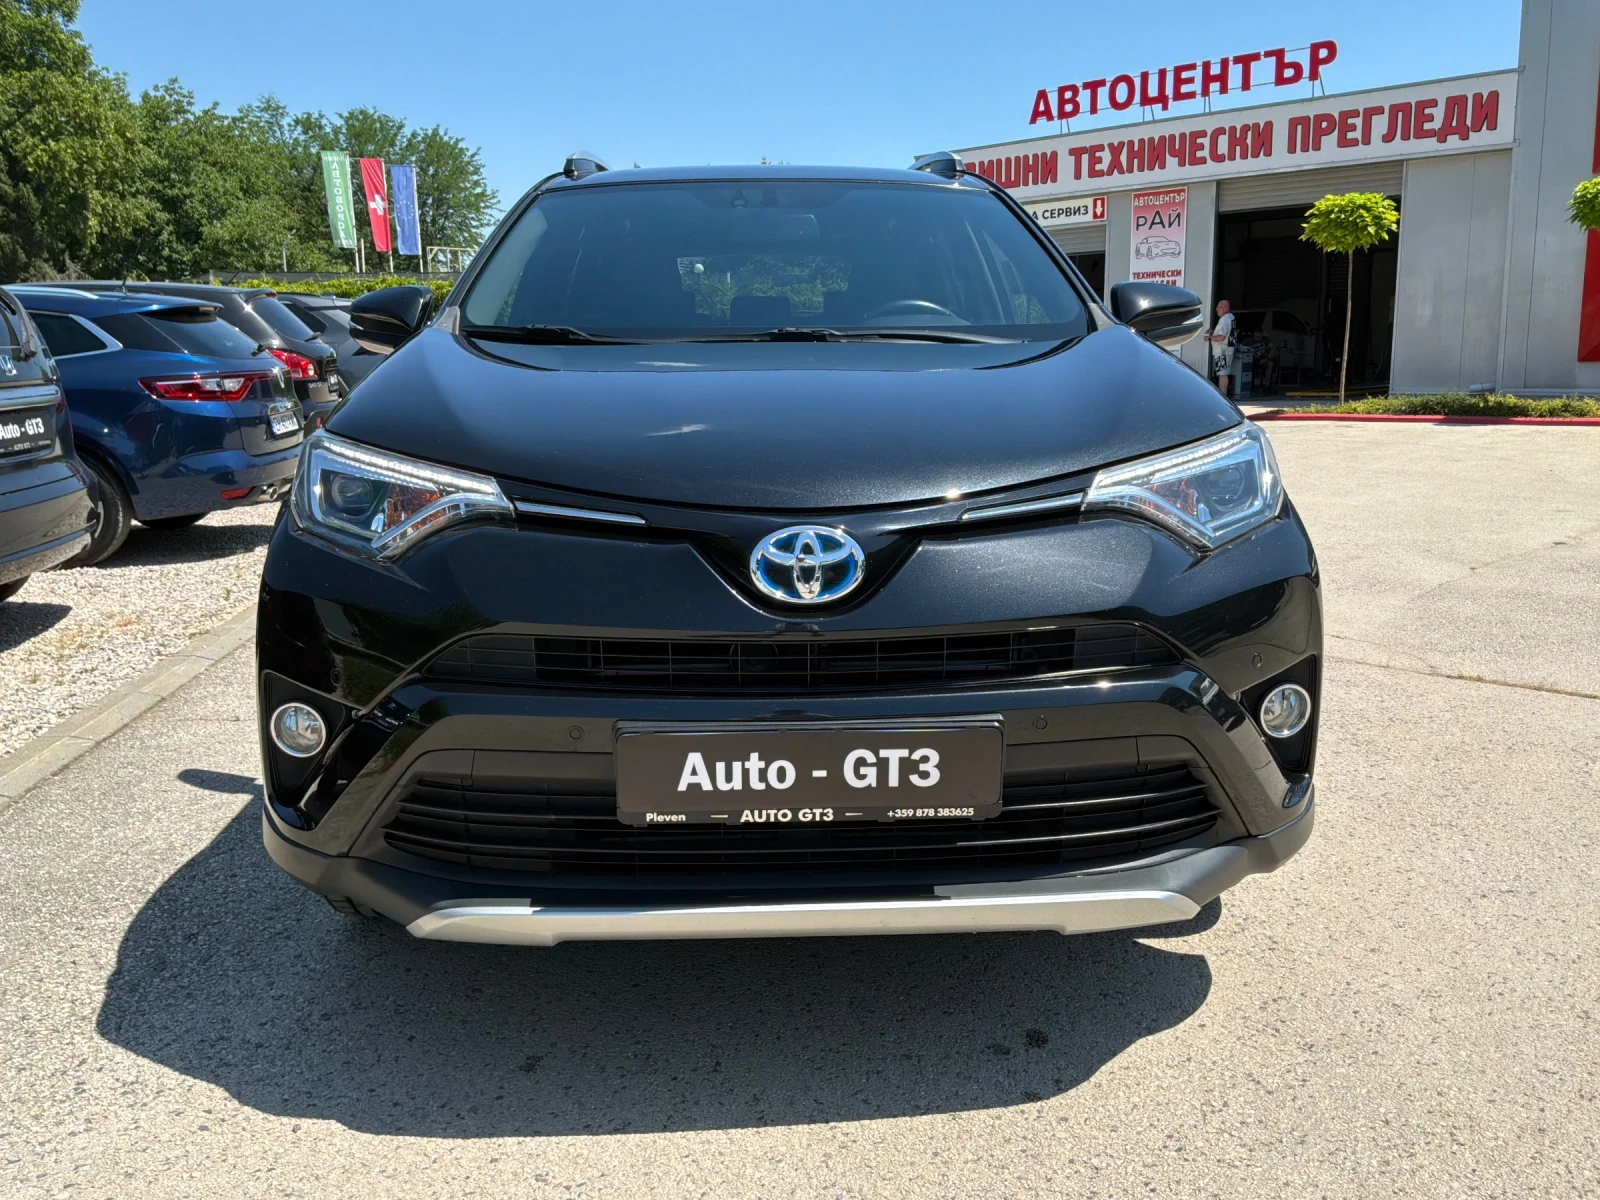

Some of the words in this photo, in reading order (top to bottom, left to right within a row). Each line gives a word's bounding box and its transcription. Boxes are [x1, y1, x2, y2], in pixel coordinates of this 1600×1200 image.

[1029, 40, 1338, 125] АВТОЦЕНТЪР
[1069, 121, 1274, 180] ТЕХНИЧЕСКИ
[1287, 90, 1500, 154] ПРЕГЛЕДИ
[1134, 193, 1185, 207] АВТОЦЕНТЪР
[1042, 205, 1089, 220] СЕРВИЗ
[1132, 269, 1182, 280] ТЕХНИЧЕСКИ
[25, 417, 45, 435] GT3
[677, 752, 796, 792] Auto
[843, 747, 941, 788] GT3
[646, 812, 686, 822] Pleven
[740, 809, 792, 823] AUTO
[798, 808, 834, 822] GT3
[887, 809, 914, 818] +359
[915, 808, 935, 817] 878
[937, 807, 974, 816] 383625
